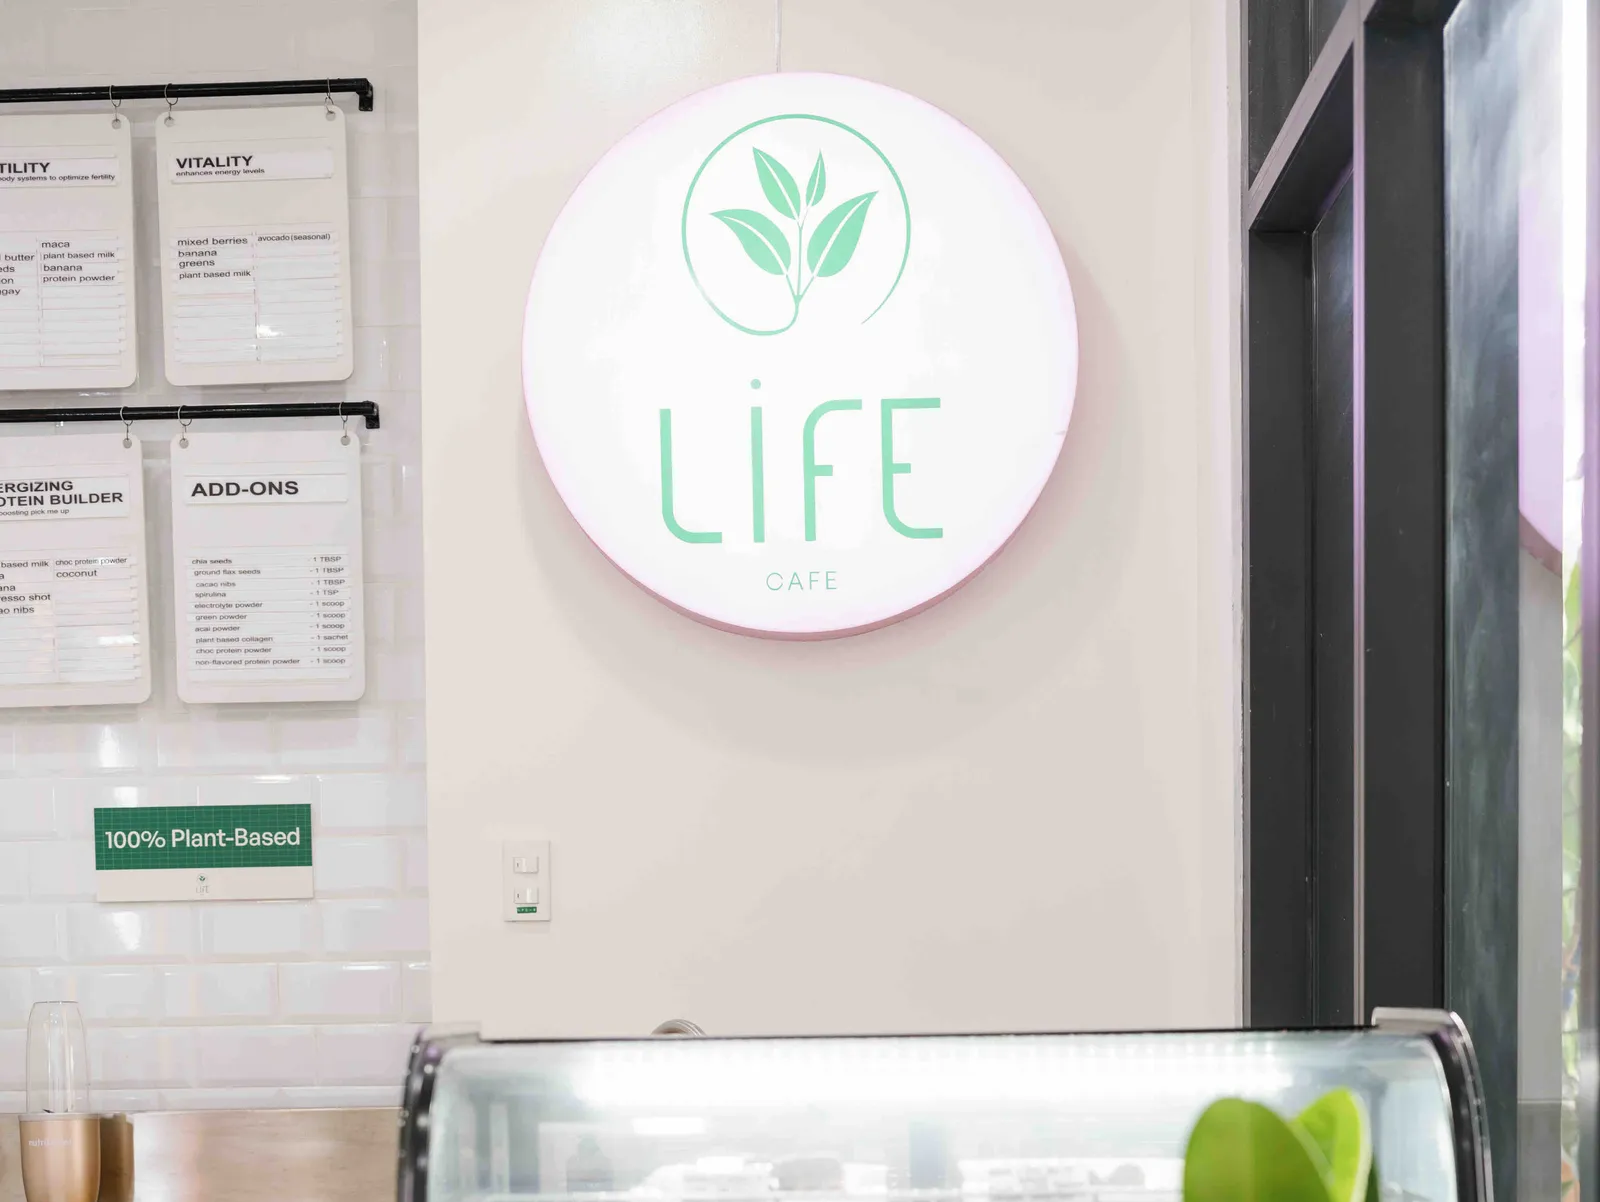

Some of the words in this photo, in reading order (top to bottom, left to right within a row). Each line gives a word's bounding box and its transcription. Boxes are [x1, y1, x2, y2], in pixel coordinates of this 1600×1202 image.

[176, 155, 253, 168] VITALITY
[92, 174, 116, 182] fertility
[178, 238, 208, 246] mixed
[212, 236, 248, 245] berries
[178, 250, 218, 258] banana
[179, 260, 215, 269] greens
[80, 274, 115, 283] powder
[179, 272, 201, 280] plant
[191, 480, 299, 496] ADD-ONS
[50, 492, 123, 505] BUILDER
[100, 557, 128, 565] powder
[766, 571, 838, 591] CAFE
[105, 830, 166, 849] 100%
[172, 827, 300, 847] Plant-Based
